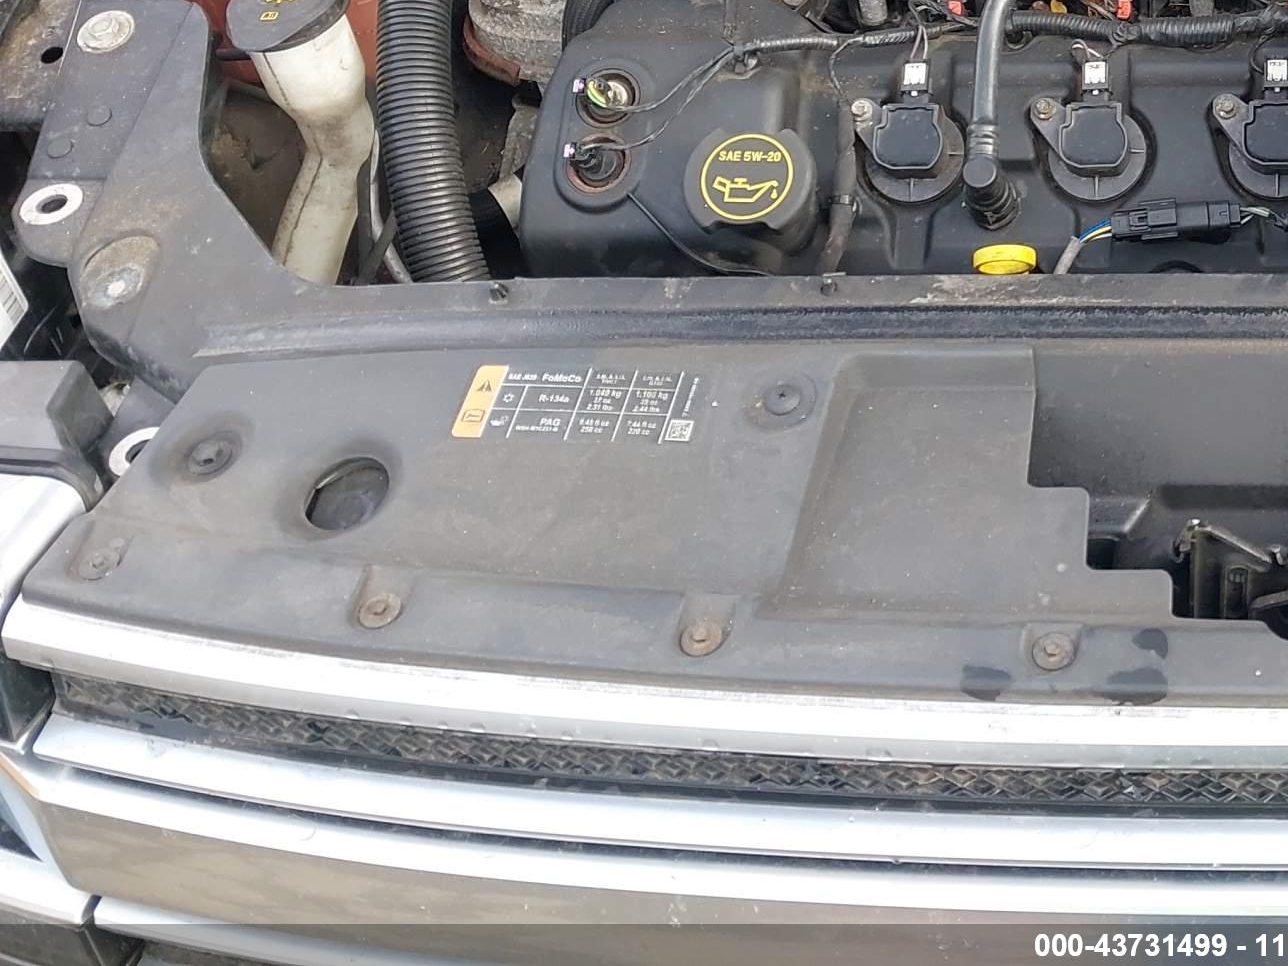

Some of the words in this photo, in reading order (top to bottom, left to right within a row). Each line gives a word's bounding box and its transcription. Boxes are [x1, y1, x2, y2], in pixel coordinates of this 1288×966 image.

[718, 150, 741, 162] SAE
[743, 151, 782, 162] 5W-20
[542, 373, 582, 382] FoMoCo
[538, 393, 570, 403] R-134a
[539, 417, 561, 426] PAG
